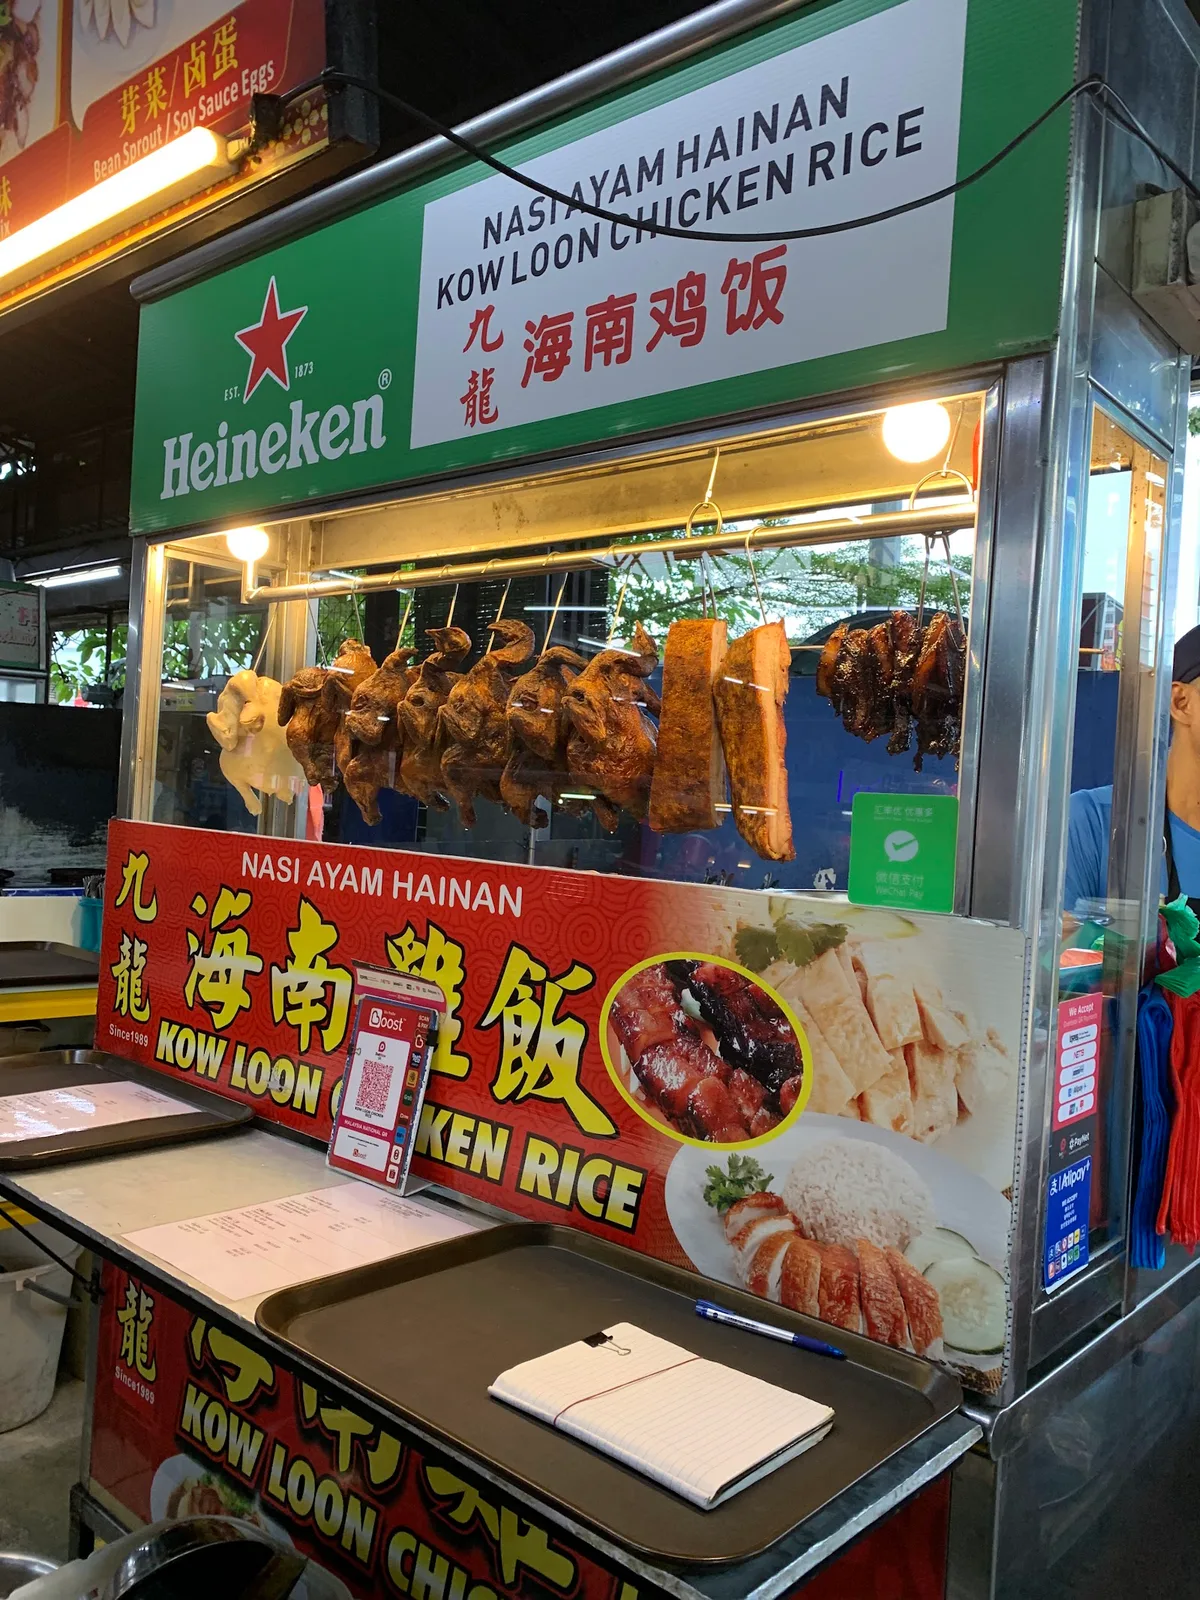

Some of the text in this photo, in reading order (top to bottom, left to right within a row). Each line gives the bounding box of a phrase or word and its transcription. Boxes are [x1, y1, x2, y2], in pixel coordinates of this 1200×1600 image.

[93, 154, 121, 183] Bean
[123, 123, 163, 167] Sprout
[173, 106, 196, 137] Soy
[198, 80, 239, 121] Sauce
[241, 59, 275, 98] Eggs
[482, 75, 850, 250] NASI AYAM HAINAN
[436, 106, 925, 310] KOW LOON CHICKEN RICE
[459, 303, 505, 428] 九龍
[519, 243, 789, 390] 海南鸡饭
[223, 385, 241, 402] EST.
[293, 361, 314, 379] 1873
[159, 393, 388, 500] Heineken
[240, 851, 300, 883] NASI
[307, 861, 384, 898] AYAM
[391, 870, 523, 918] HAINAN
[875, 870, 924, 888] 微信支付
[875, 884, 924, 901] WeChat Pay
[110, 849, 158, 1023] 九龍
[108, 1022, 150, 1048] Since1989
[1069, 1002, 1094, 1017] We Accept
[157, 1018, 322, 1115] KOW LOON
[344, 1119, 362, 1130] MALAYSIA
[518, 1134, 646, 1233] RICE
[116, 1279, 158, 1386] 龍
[113, 1365, 156, 1405] Since1989
[181, 1379, 266, 1478] KOW
[266, 1440, 381, 1565] LOON
[386, 1530, 500, 1600] CHI
